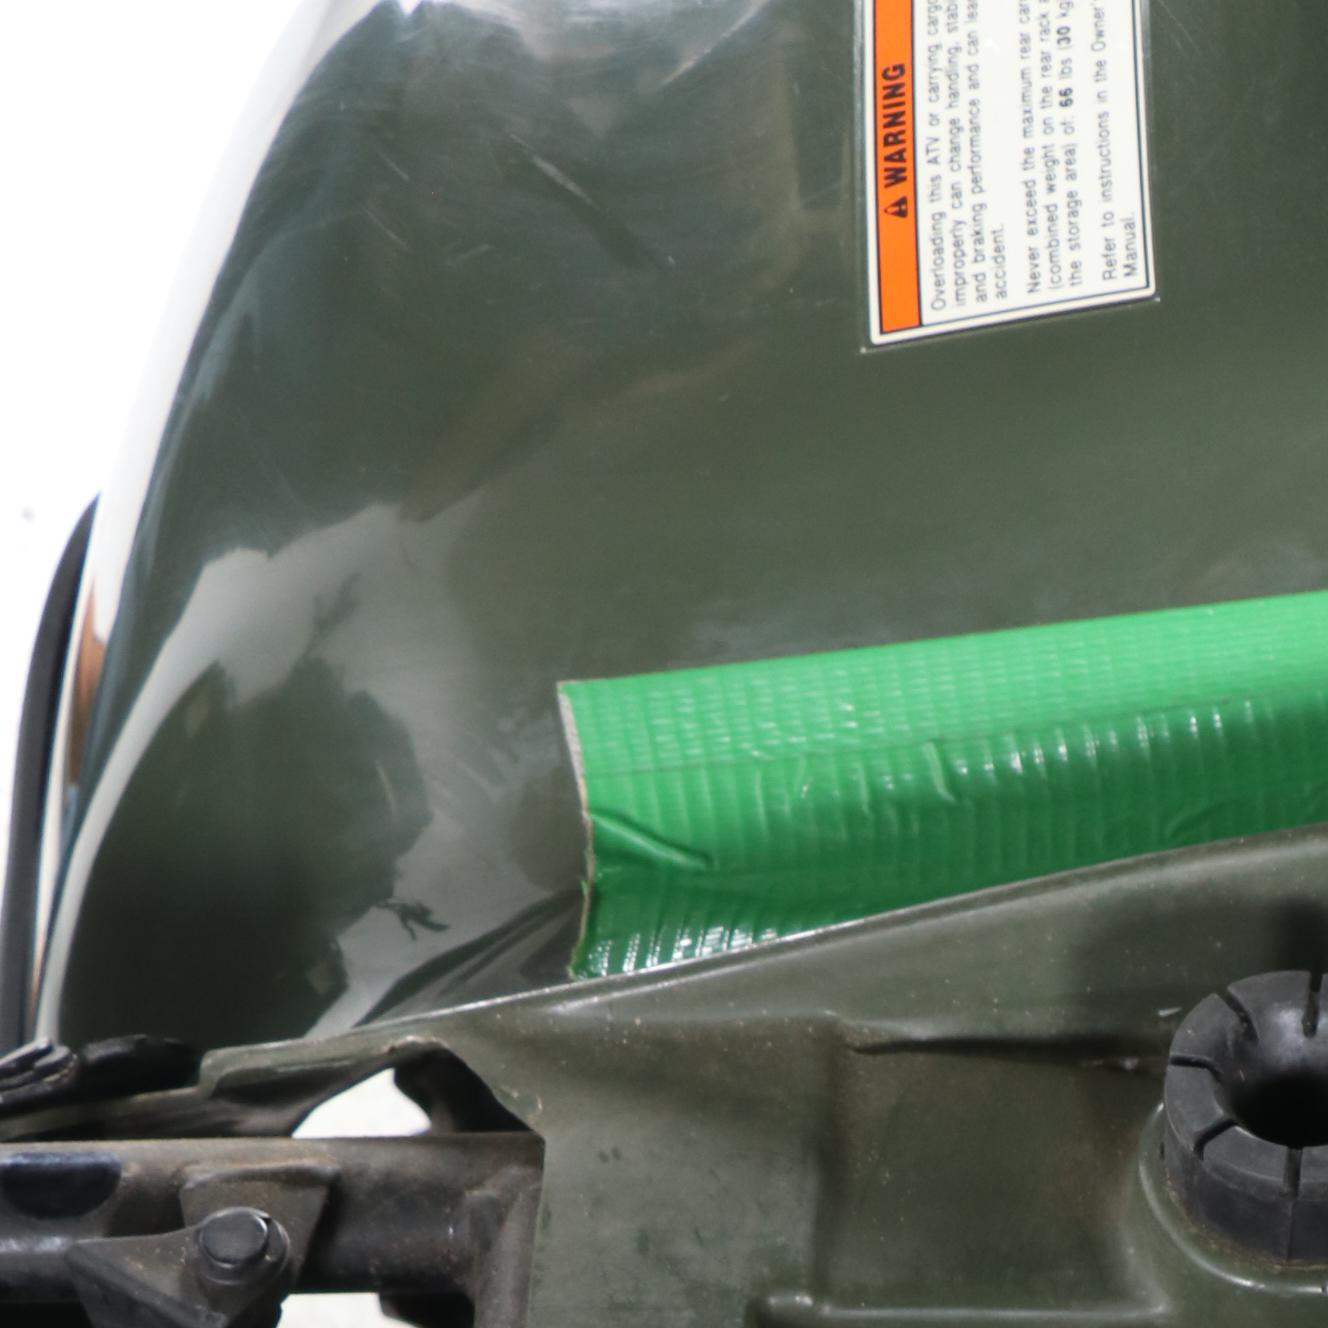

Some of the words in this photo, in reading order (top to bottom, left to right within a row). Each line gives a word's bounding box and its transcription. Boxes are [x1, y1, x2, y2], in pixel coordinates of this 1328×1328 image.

[1037, 12, 1051, 42] rack
[967, 30, 979, 57] can
[1019, 32, 1031, 60] rear
[928, 43, 942, 103] carrying
[966, 63, 980, 91] and
[1040, 51, 1052, 78] rear
[1058, 57, 1073, 80] lbs
[1093, 59, 1108, 83] the
[1020, 67, 1034, 139] maximum
[1040, 85, 1054, 109] the
[1058, 87, 1074, 108] 66
[1096, 90, 1108, 104] in
[881, 62, 908, 188] WARNING
[929, 113, 940, 127] or
[1042, 116, 1055, 136] on
[926, 136, 940, 165] ATV
[948, 117, 964, 173] change
[967, 98, 984, 195] performance
[1021, 146, 1035, 172] the
[1097, 111, 1113, 203] instructions
[1041, 144, 1060, 195] weight
[1062, 142, 1079, 181] area)
[929, 173, 942, 203] this
[950, 181, 962, 209] can
[1022, 179, 1038, 236] exceed
[1066, 190, 1082, 251] storage
[1101, 211, 1115, 228] to
[971, 202, 987, 263] braking
[1044, 203, 1064, 290] (combined
[930, 211, 946, 311] Overloading
[950, 219, 967, 306] improperly
[1027, 246, 1041, 294] Never
[1068, 260, 1083, 287] the
[1101, 237, 1118, 281] Refer
[973, 271, 987, 303] and
